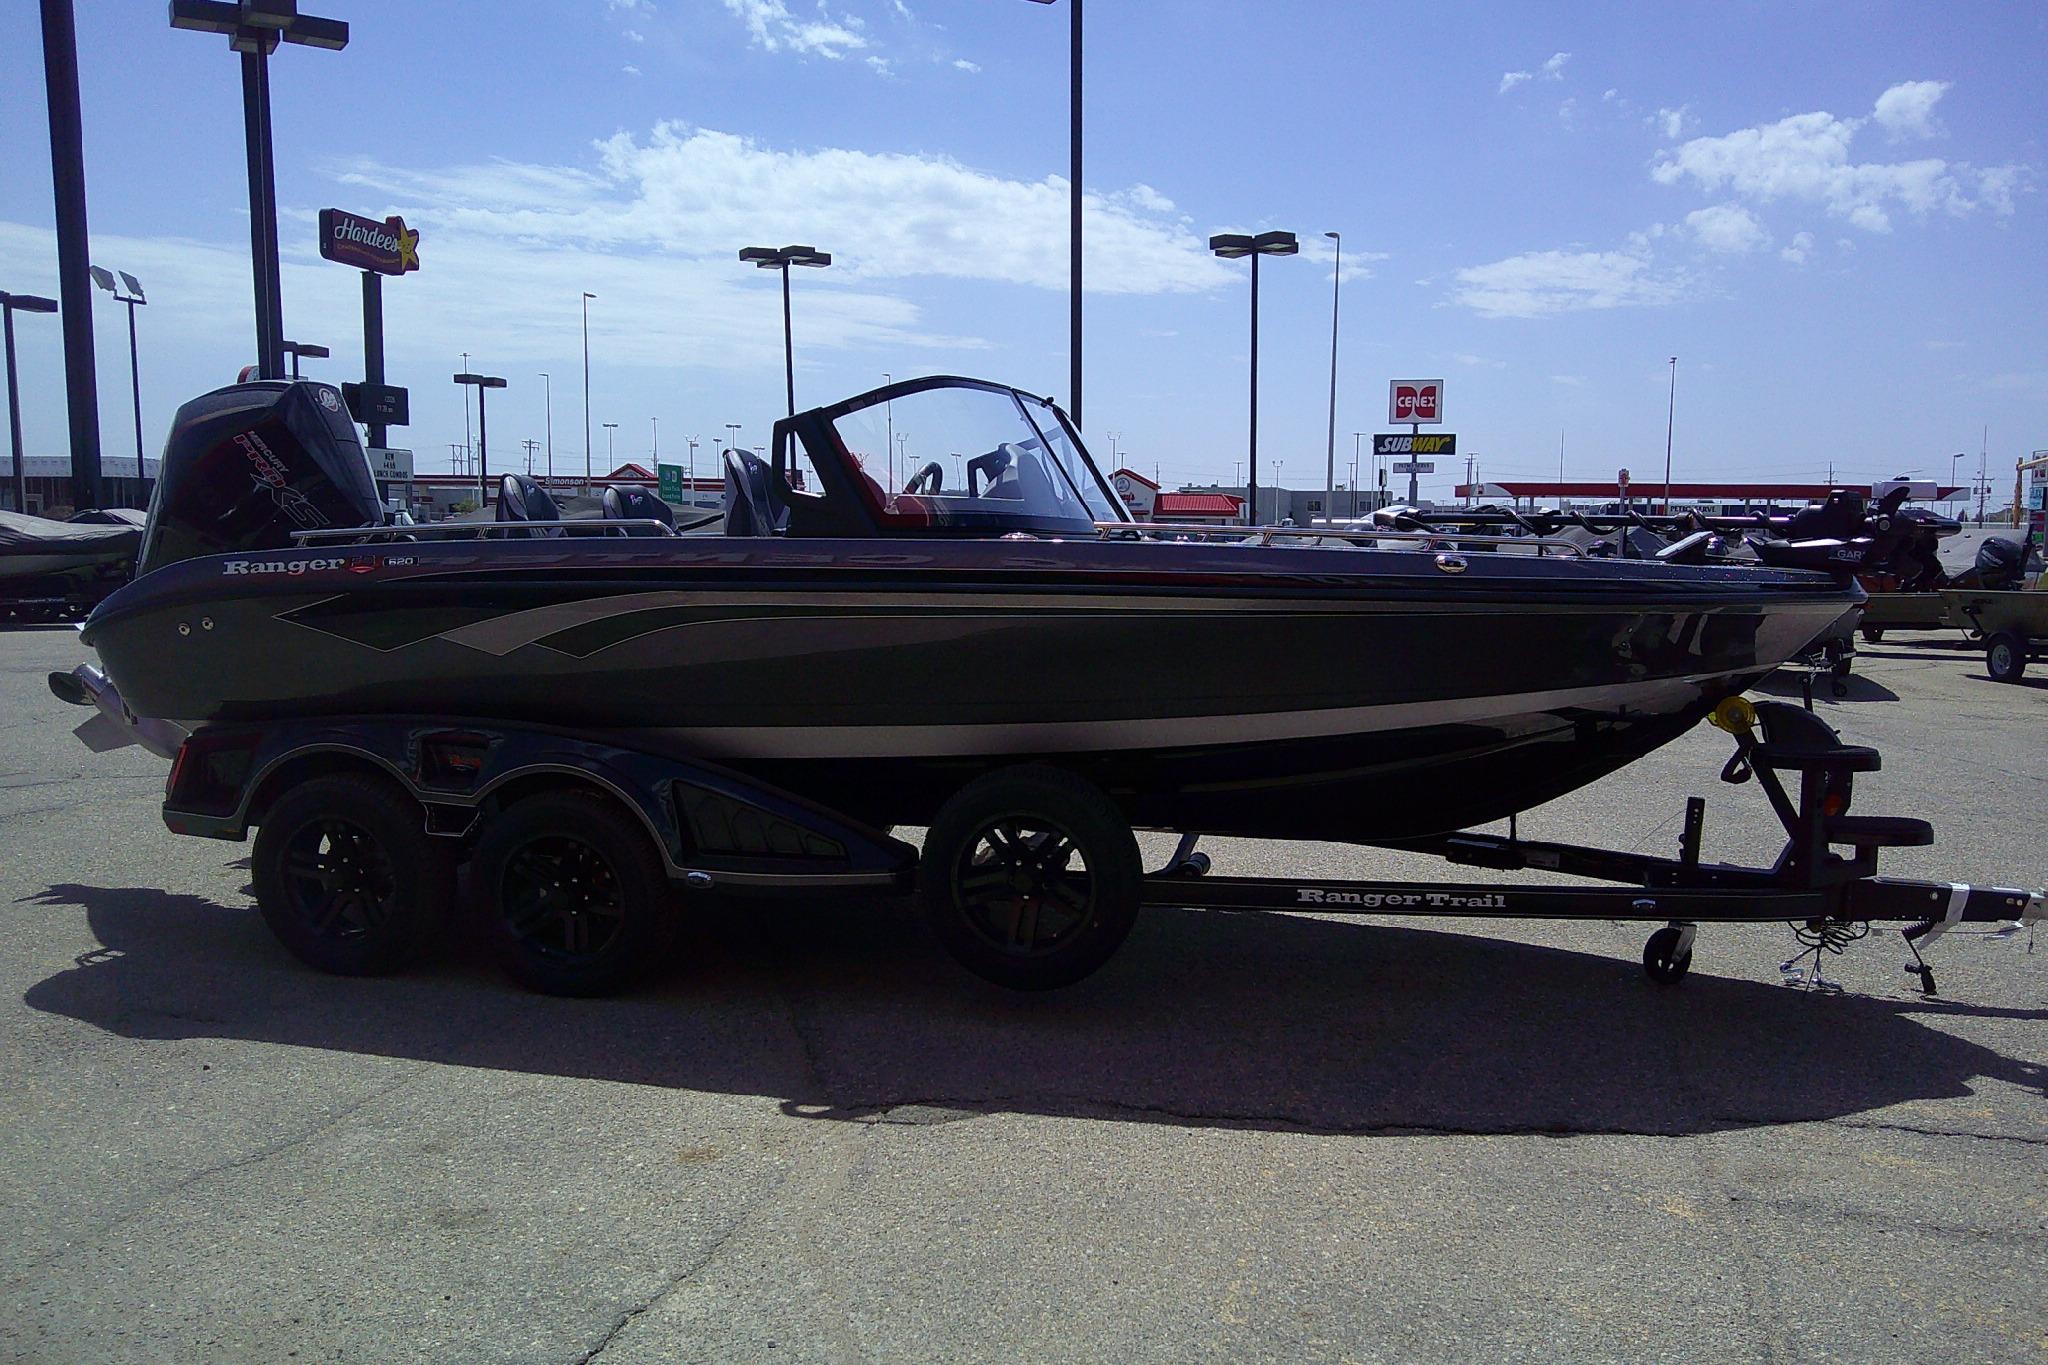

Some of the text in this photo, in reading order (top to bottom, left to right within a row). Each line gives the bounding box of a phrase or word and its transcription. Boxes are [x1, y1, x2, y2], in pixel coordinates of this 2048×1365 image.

[334, 218, 398, 252] Hardee's
[1397, 396, 1435, 408] CENEX
[248, 430, 290, 473] MERCURY
[1378, 436, 1451, 453] SUBWAY
[233, 433, 286, 489] PRO
[545, 477, 584, 486] Simonson
[1837, 549, 1865, 560] GAR
[222, 558, 345, 576] Ranger
[388, 557, 414, 566] 620
[1297, 889, 1506, 908] Ranger Trail
